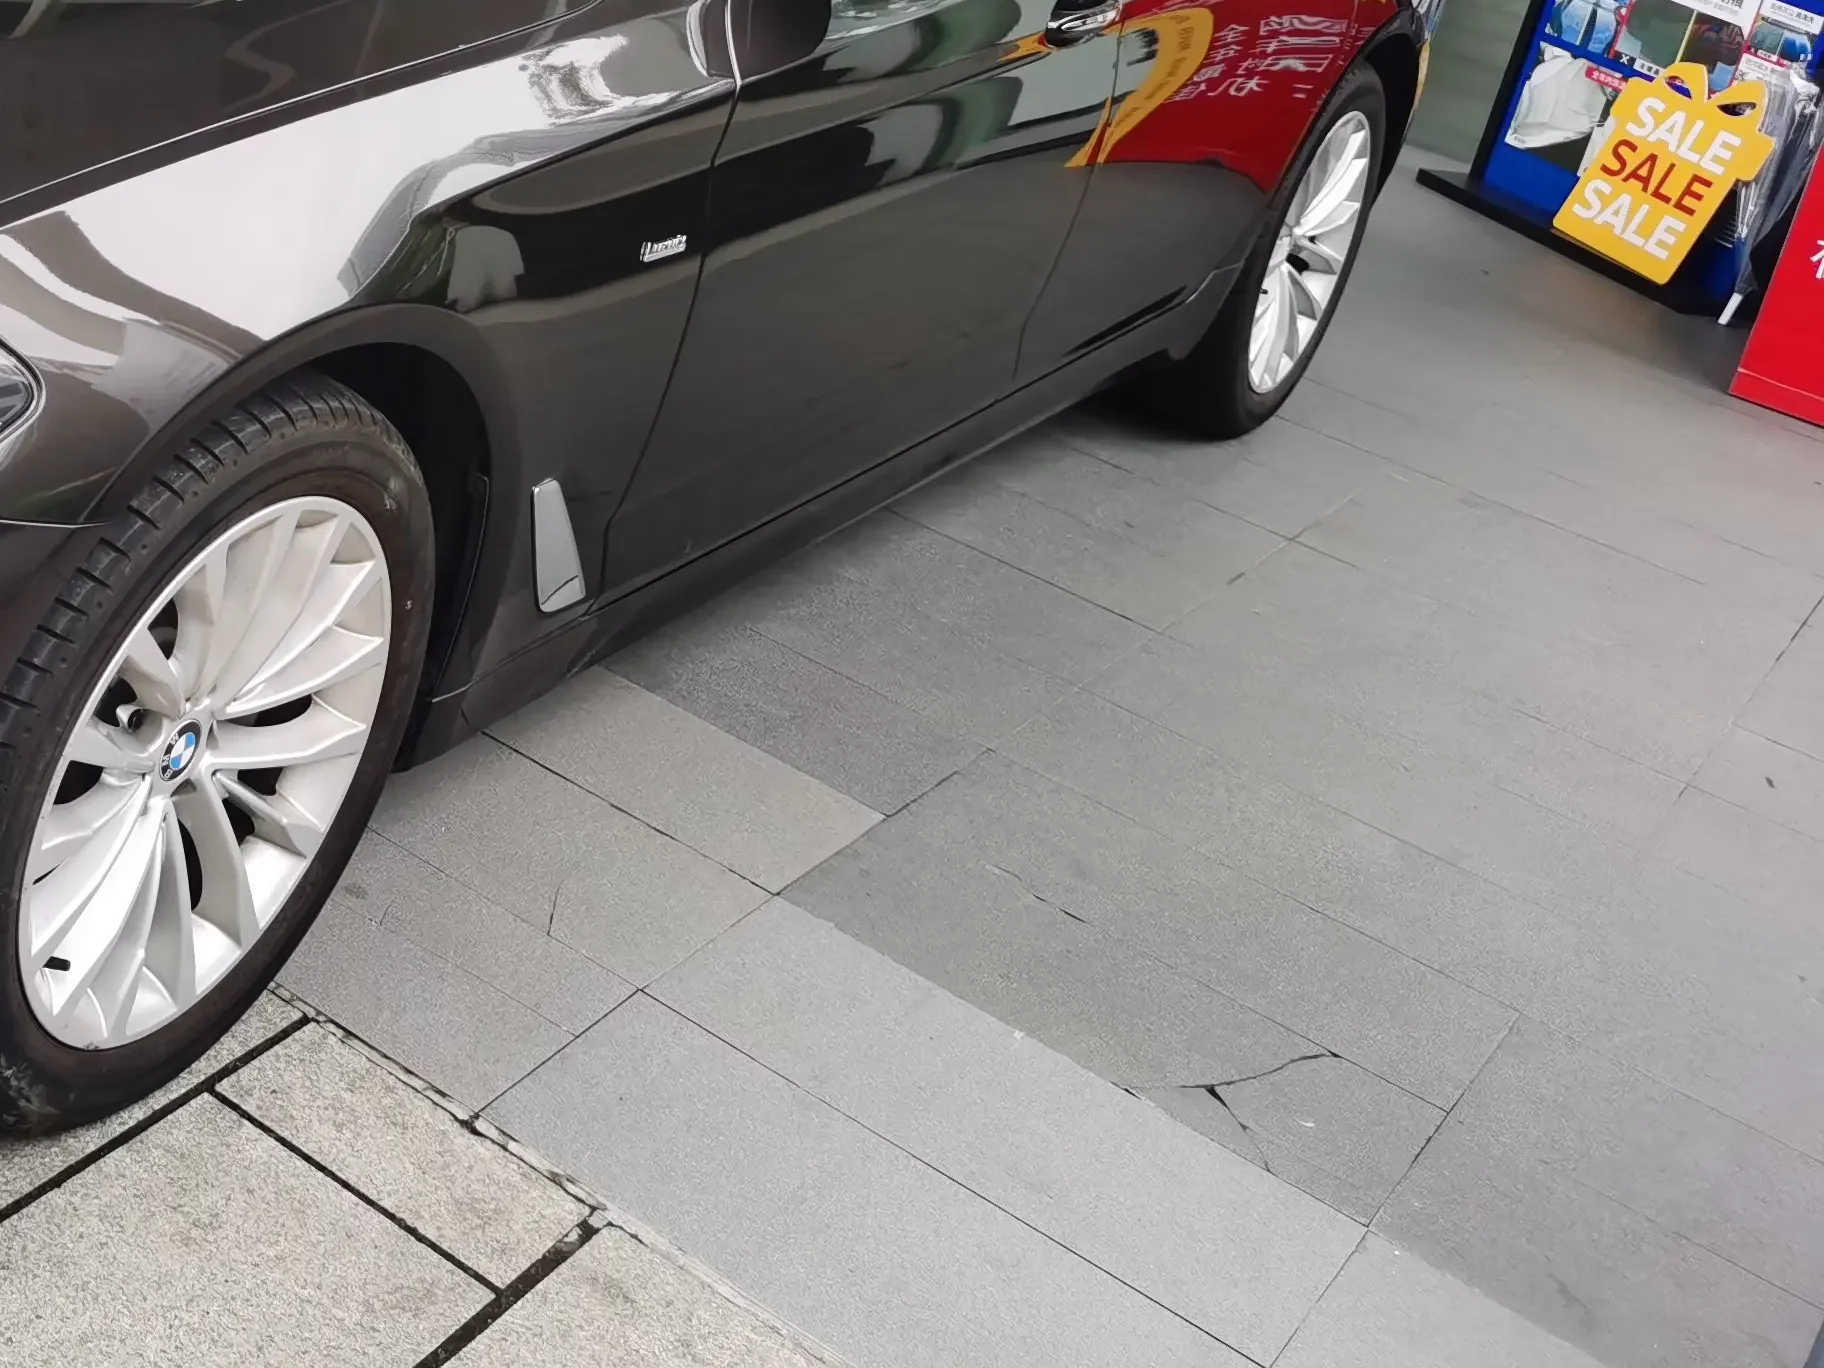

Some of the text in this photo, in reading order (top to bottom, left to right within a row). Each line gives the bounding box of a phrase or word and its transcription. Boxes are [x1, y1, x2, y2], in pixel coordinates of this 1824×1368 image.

[1625, 97, 1742, 177] SALE
[1599, 138, 1714, 218] SALE
[1571, 179, 1687, 261] SALE
